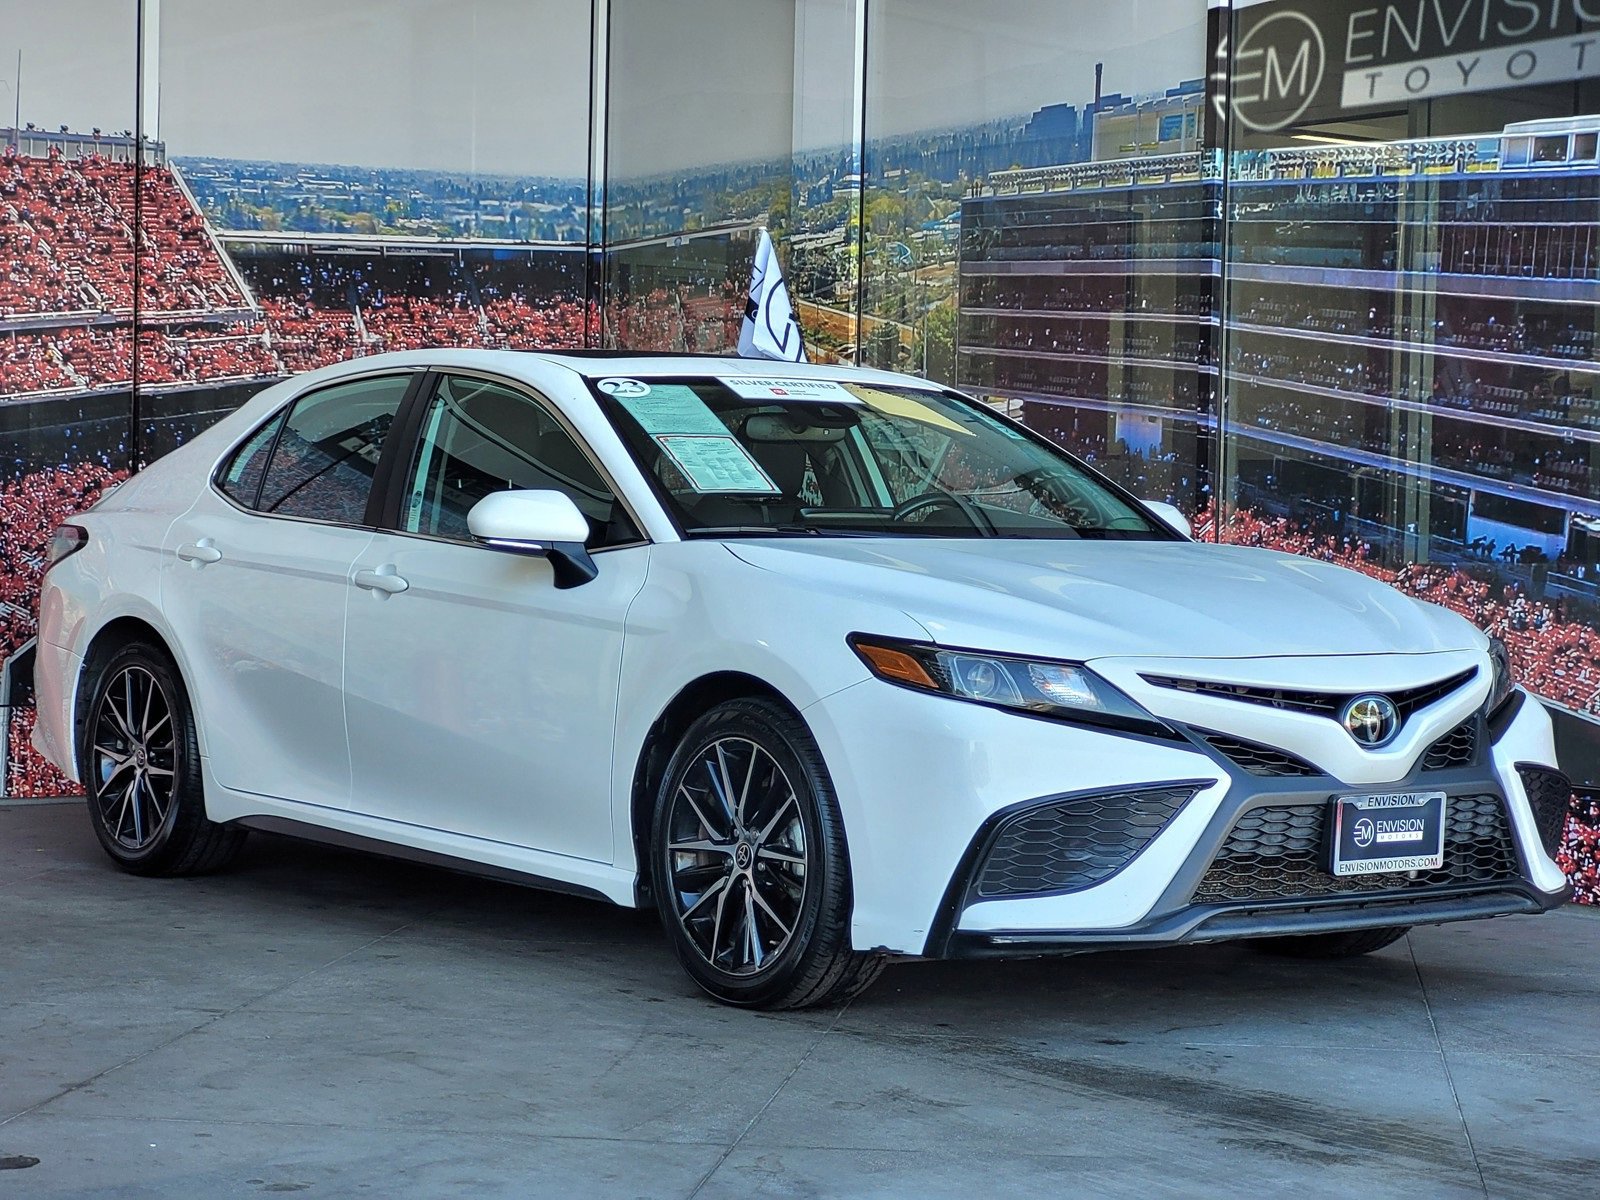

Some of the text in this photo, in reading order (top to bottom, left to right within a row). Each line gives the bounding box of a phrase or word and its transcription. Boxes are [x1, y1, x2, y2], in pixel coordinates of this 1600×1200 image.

[602, 380, 646, 394] 23
[729, 379, 837, 390] SILVER CERTIFIED
[1367, 795, 1416, 807] ENVISION
[1376, 819, 1425, 833] ENVISION
[1339, 857, 1439, 873] ENVISIONMOTORS.COM
